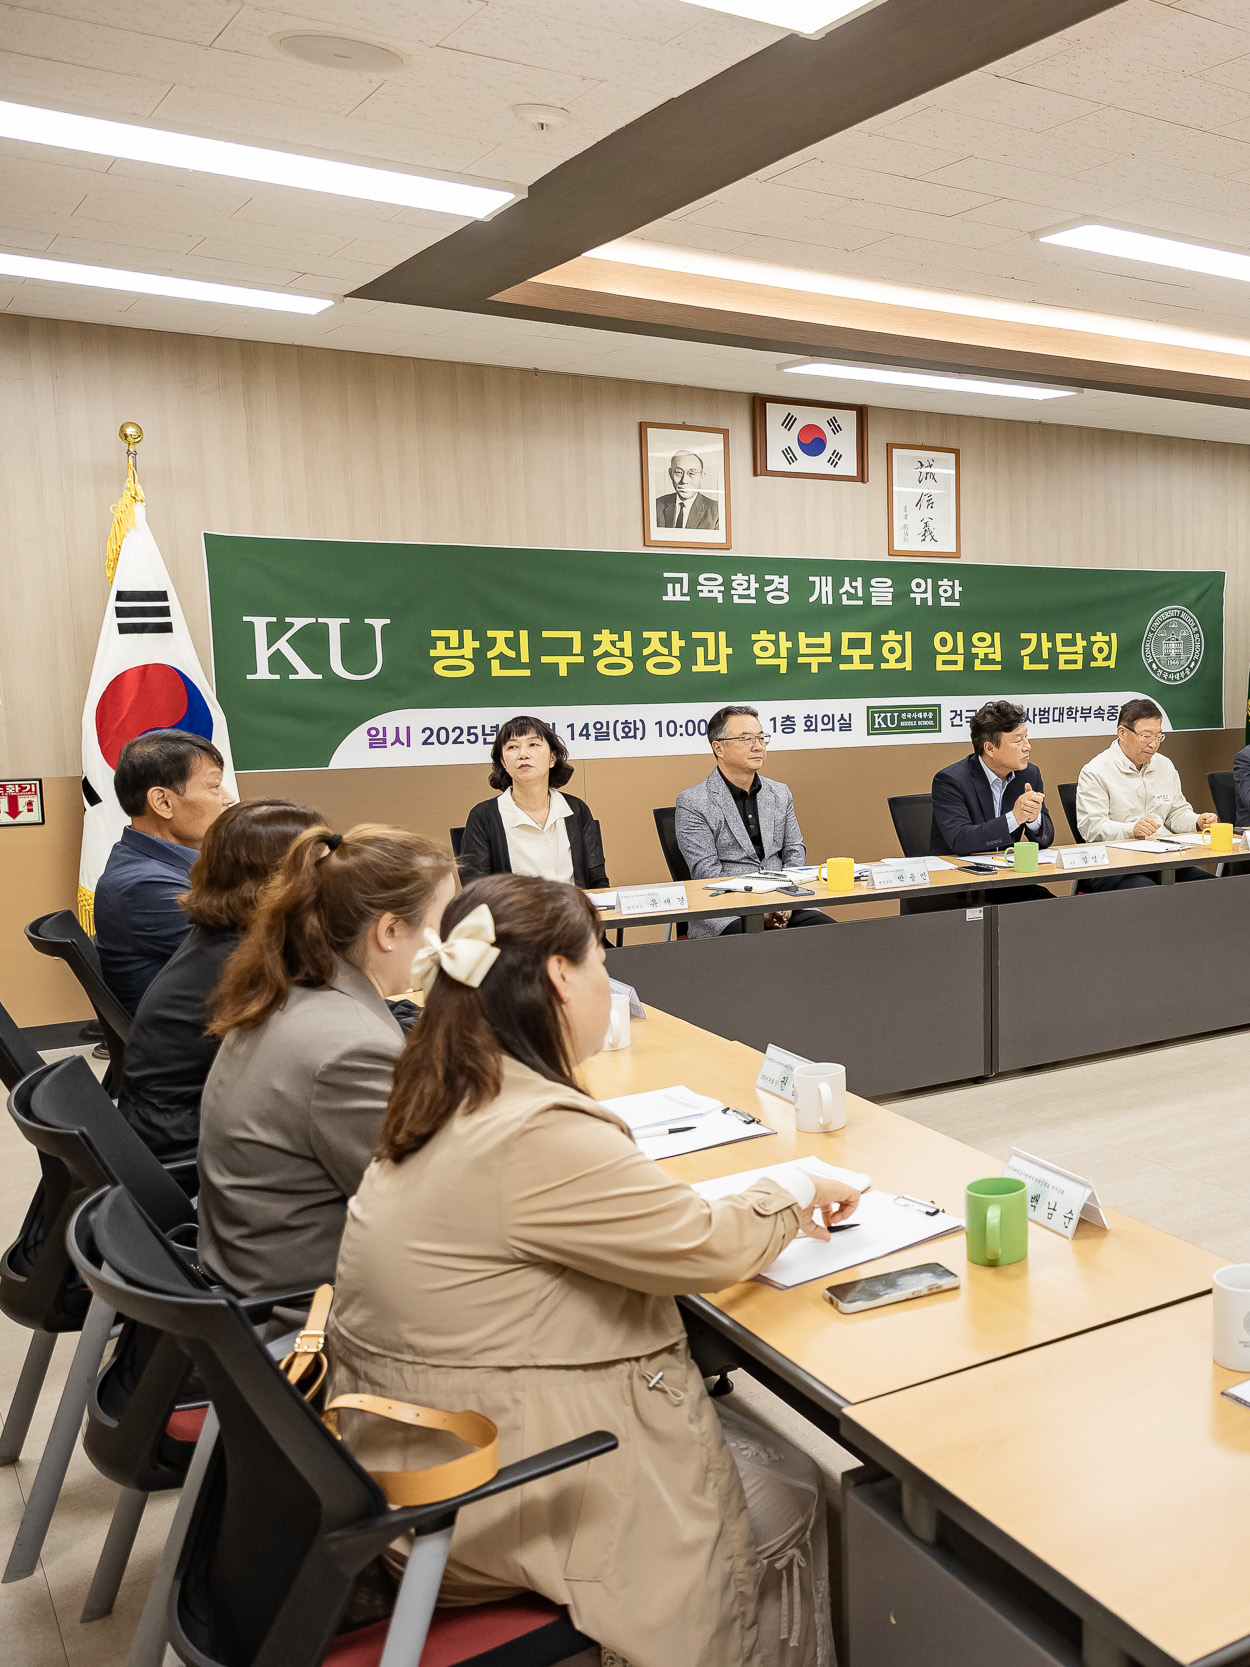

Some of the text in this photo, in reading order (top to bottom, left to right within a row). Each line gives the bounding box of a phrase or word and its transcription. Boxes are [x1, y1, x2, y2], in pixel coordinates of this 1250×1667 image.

[662, 571, 963, 607] 교육환경 개선을 위한
[242, 615, 391, 681] KU
[429, 629, 1118, 678] 광진구청장과 학부모회 임원 간담회
[1144, 609, 1201, 663] KONKUK UNIVERSITY MIDDLE SCHOOL
[1157, 667, 1191, 681] 건국사대부중
[366, 713, 853, 749] 일시 2025년 14일(화) 10:00 1층 회의실
[873, 713, 899, 728] KU
[901, 711, 934, 720] 건국사대부중
